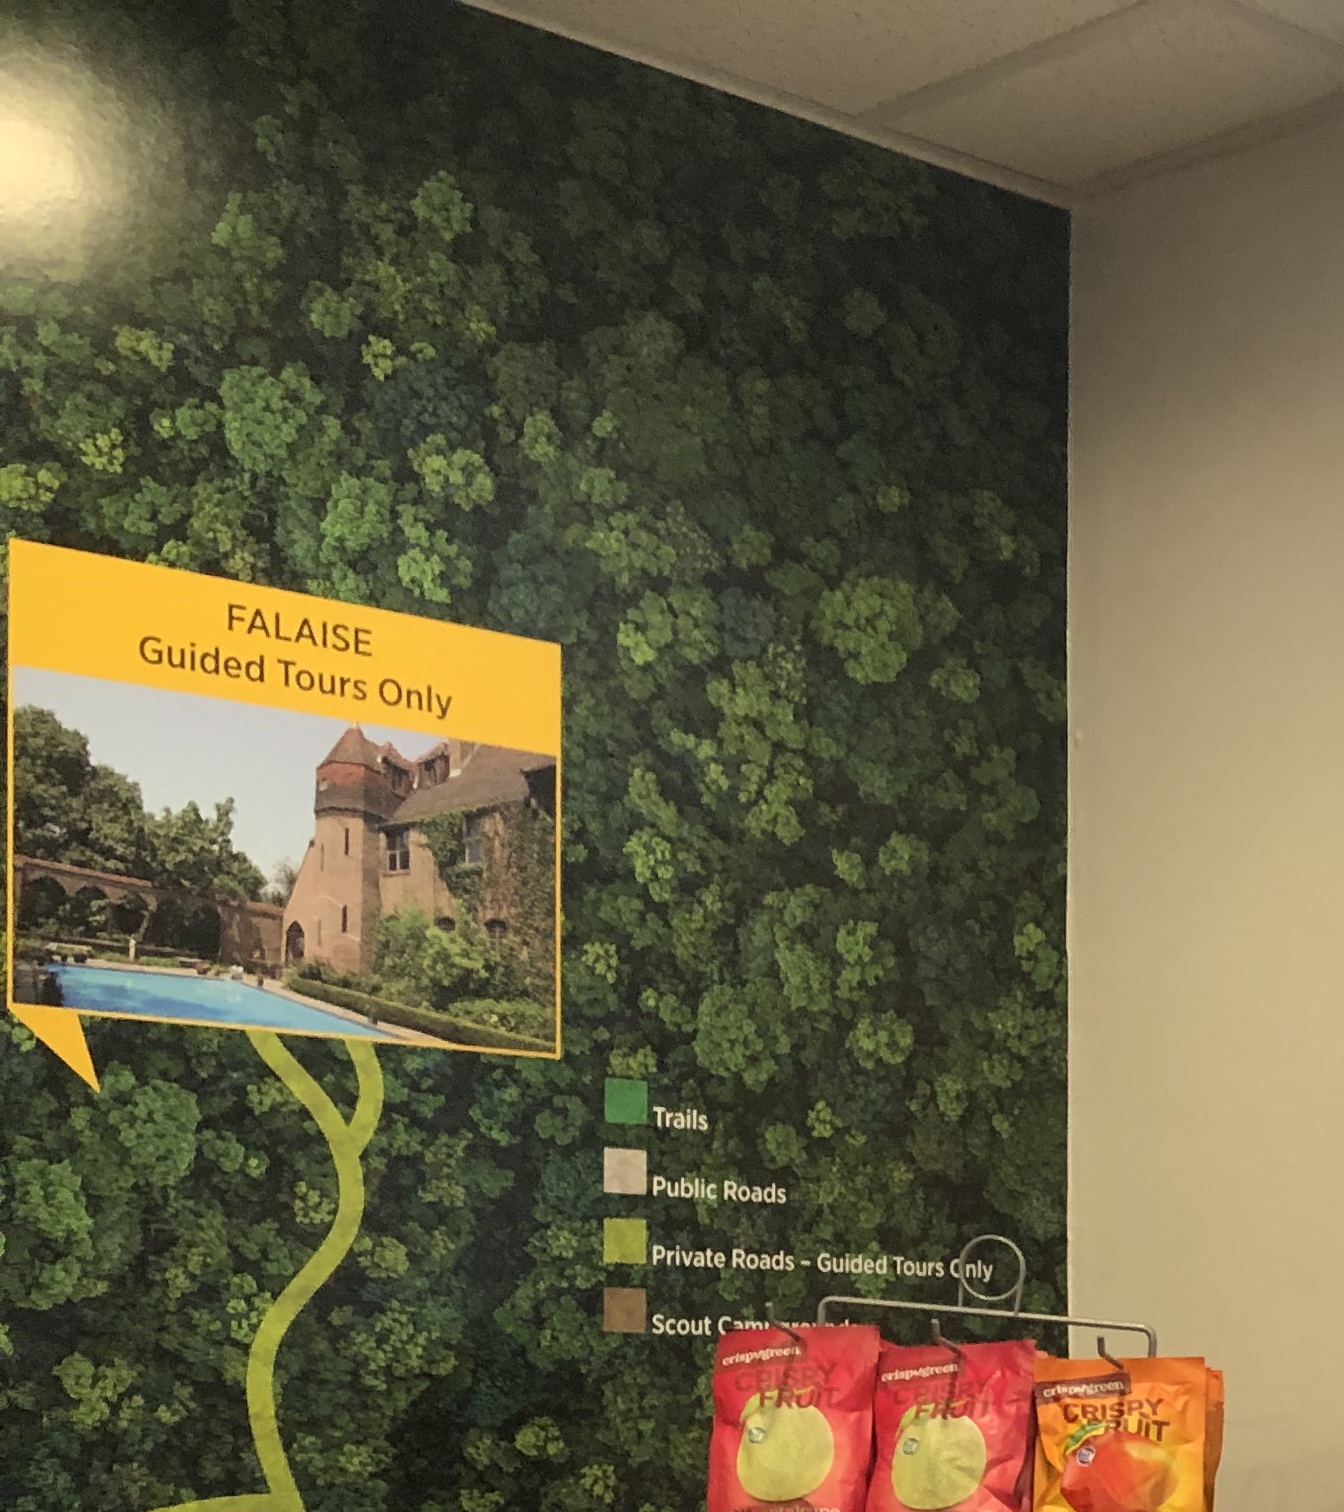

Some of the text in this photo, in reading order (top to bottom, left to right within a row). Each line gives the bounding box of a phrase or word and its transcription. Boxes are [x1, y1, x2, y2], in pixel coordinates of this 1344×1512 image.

[226, 603, 374, 657] FALAISE
[139, 635, 453, 720] Guided Tours Only
[652, 1105, 709, 1131] Trails
[652, 1176, 787, 1204] Public Roads
[652, 1245, 993, 1282] Private Roads Guided Tours Only
[651, 1313, 712, 1336] Scout
[1063, 1398, 1165, 1424] CRISPY
[1104, 1419, 1170, 1441] RUIT
